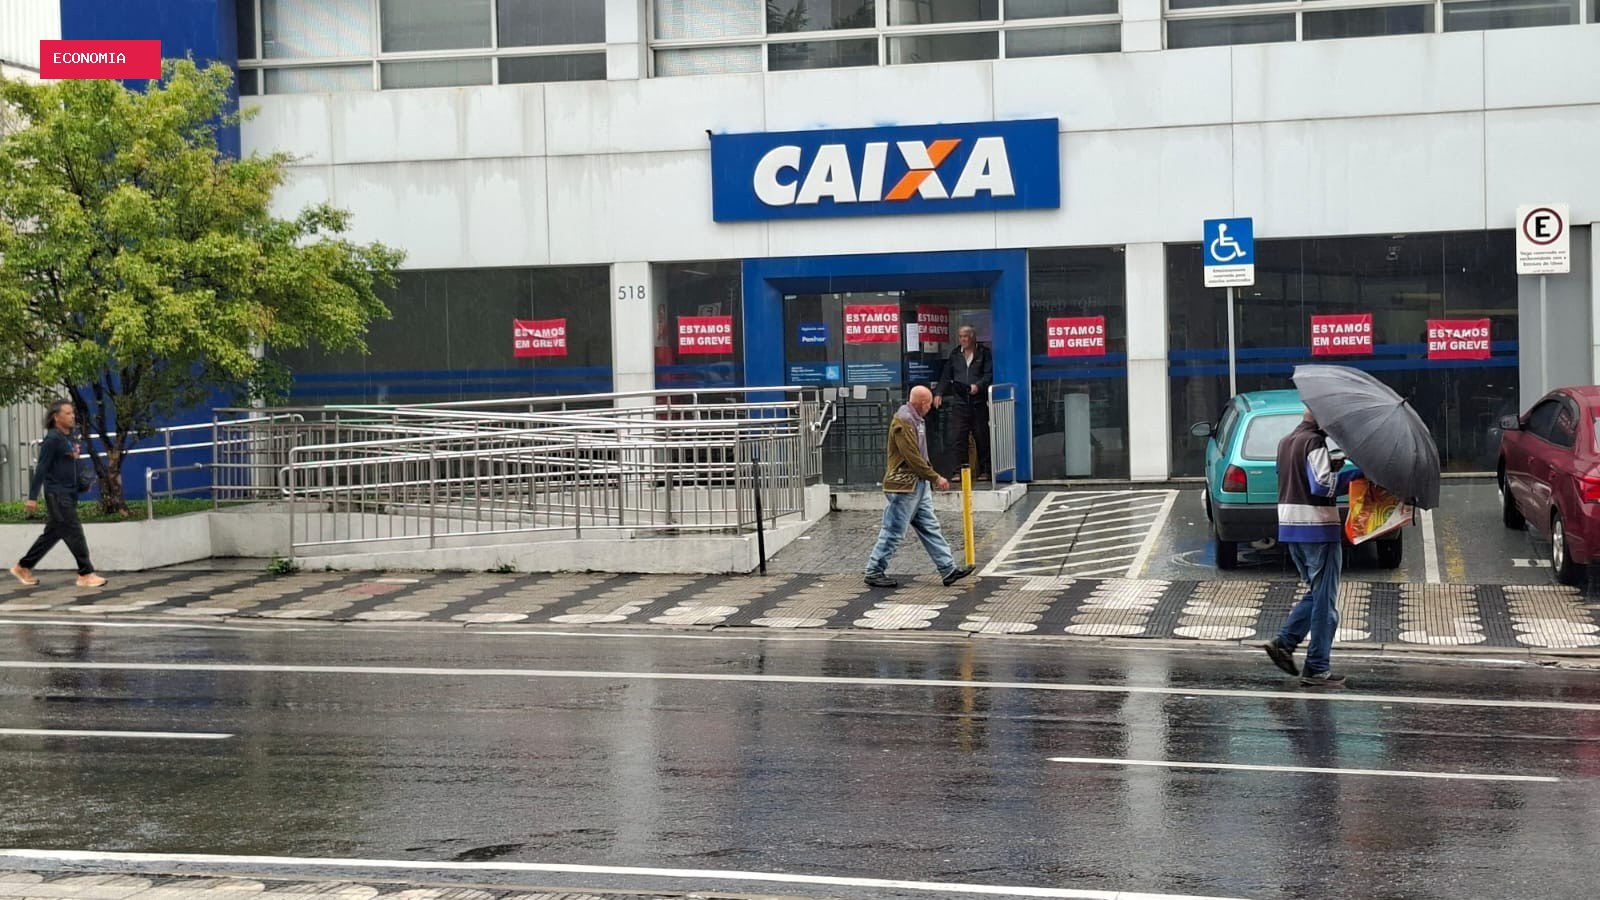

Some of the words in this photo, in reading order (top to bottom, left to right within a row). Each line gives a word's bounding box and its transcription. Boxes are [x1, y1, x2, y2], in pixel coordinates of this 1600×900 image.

[753, 136, 1016, 206] CAIXA
[1535, 216, 1550, 237] E
[618, 285, 646, 300] 518
[846, 313, 898, 322] ESTAMOS
[514, 327, 565, 338] ESTAMOS
[680, 324, 731, 334] ESTAMOS
[846, 325, 861, 334] EM
[864, 325, 898, 334] GREVE
[1048, 325, 1103, 335] ESTAMOS
[1312, 323, 1371, 333] ESTAMOS
[1429, 328, 1488, 338] ESTAMOS
[515, 340, 530, 349] EM
[532, 338, 566, 348] GREVE
[680, 337, 695, 345] EM
[697, 336, 731, 345] GREVE
[1049, 339, 1065, 348] EM
[1067, 338, 1104, 347] GREVE
[1313, 337, 1330, 346] EM
[1333, 336, 1371, 345] GREVE
[1429, 341, 1447, 350] EM
[1450, 340, 1489, 350] GREVE
